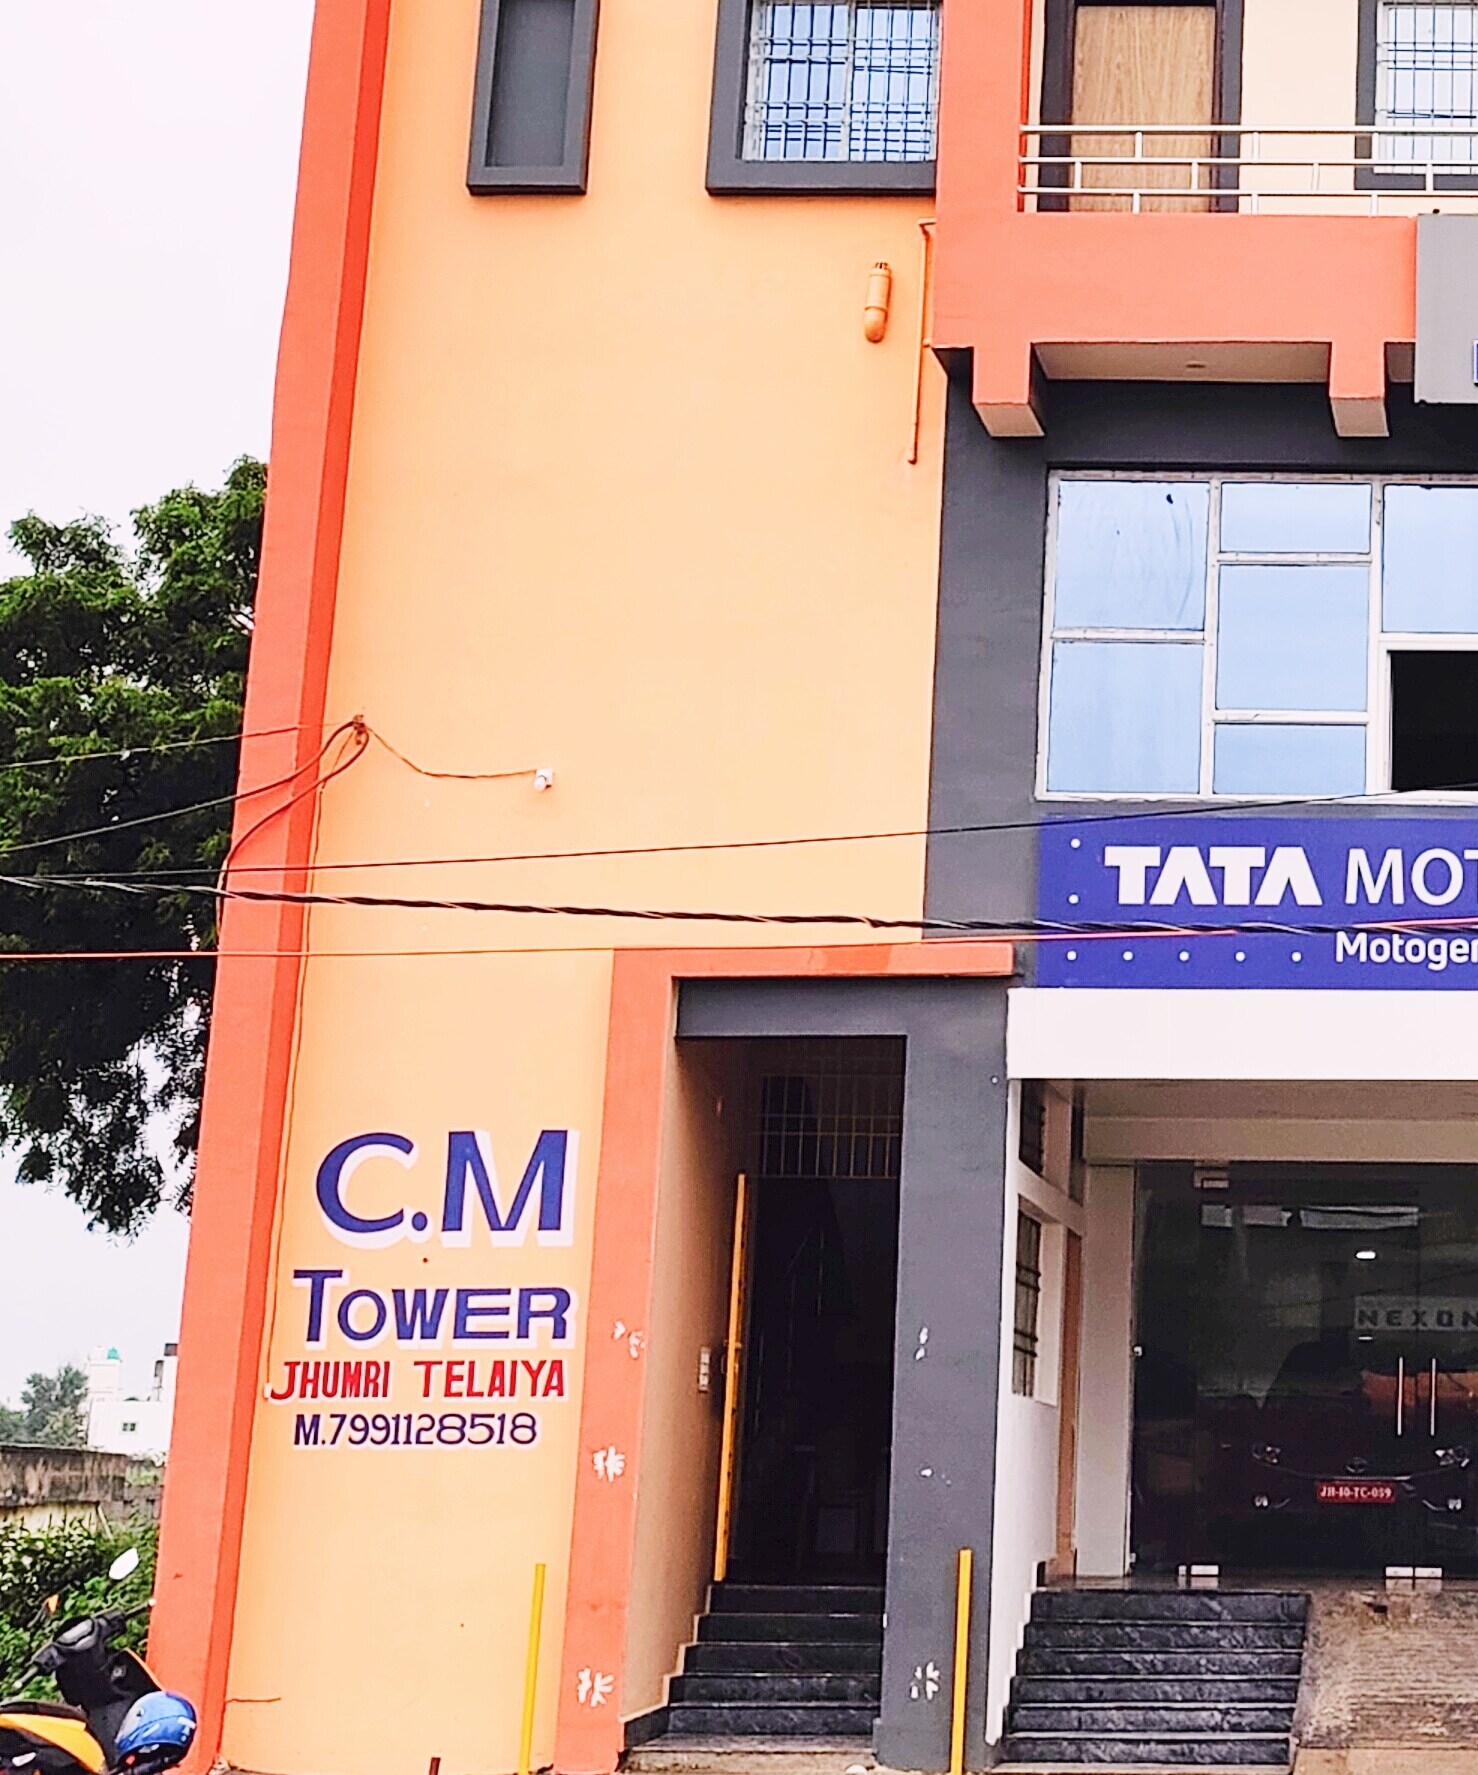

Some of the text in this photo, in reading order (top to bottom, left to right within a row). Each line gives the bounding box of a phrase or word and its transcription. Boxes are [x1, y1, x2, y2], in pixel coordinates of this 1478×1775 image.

[1104, 846, 1323, 905] TATA
[315, 1129, 573, 1240] C.M
[293, 1268, 574, 1346] TOWER
[269, 1359, 564, 1401] JHUMRI TELAIYA
[293, 1412, 537, 1446] M.7991128518
